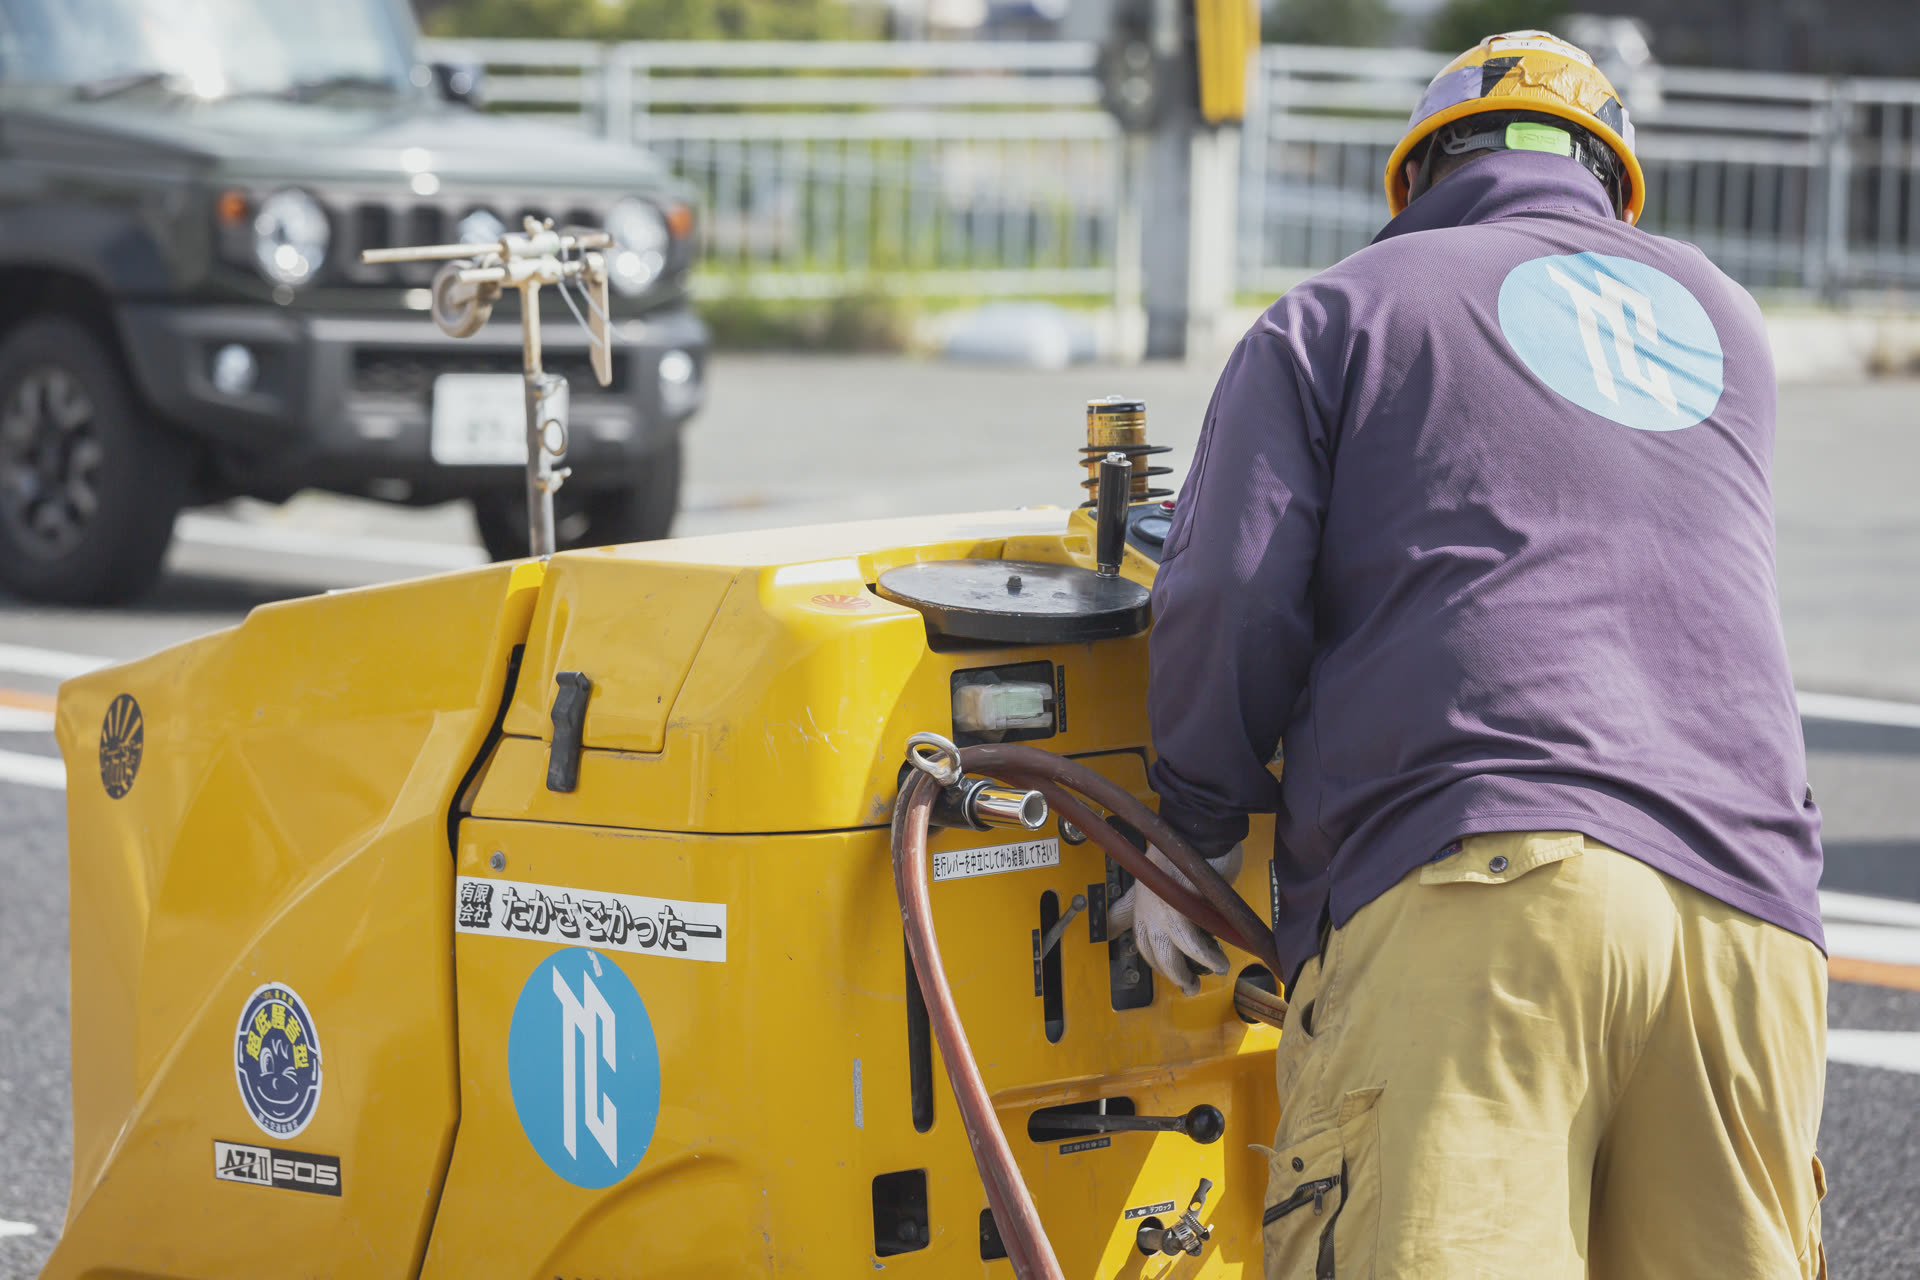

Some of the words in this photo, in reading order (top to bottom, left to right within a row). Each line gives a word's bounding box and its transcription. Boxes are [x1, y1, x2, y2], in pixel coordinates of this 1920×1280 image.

[501, 887, 721, 951] たかさごかったー
[246, 1004, 309, 1066] 超低騒音型
